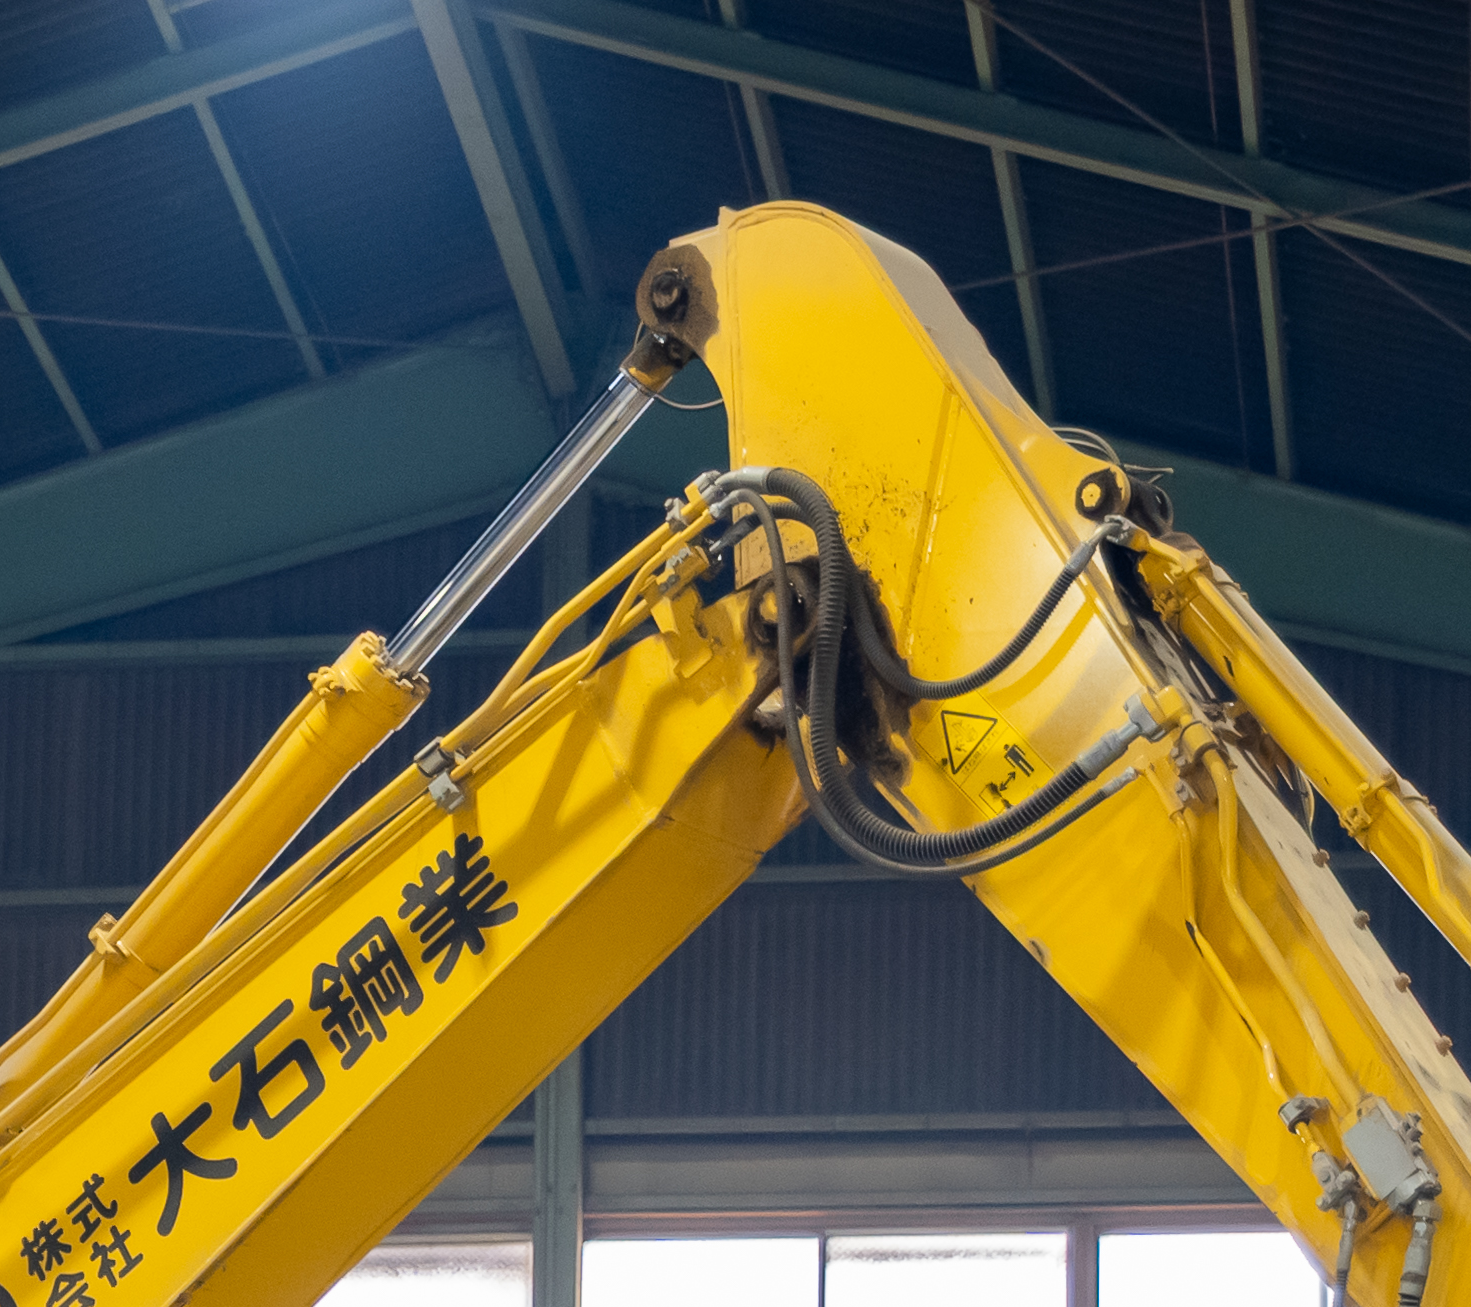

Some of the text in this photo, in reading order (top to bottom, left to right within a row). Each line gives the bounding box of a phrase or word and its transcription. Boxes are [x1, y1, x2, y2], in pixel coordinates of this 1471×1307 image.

[128, 832, 520, 1237] 大石鋼業
[20, 1173, 119, 1282] 株式
